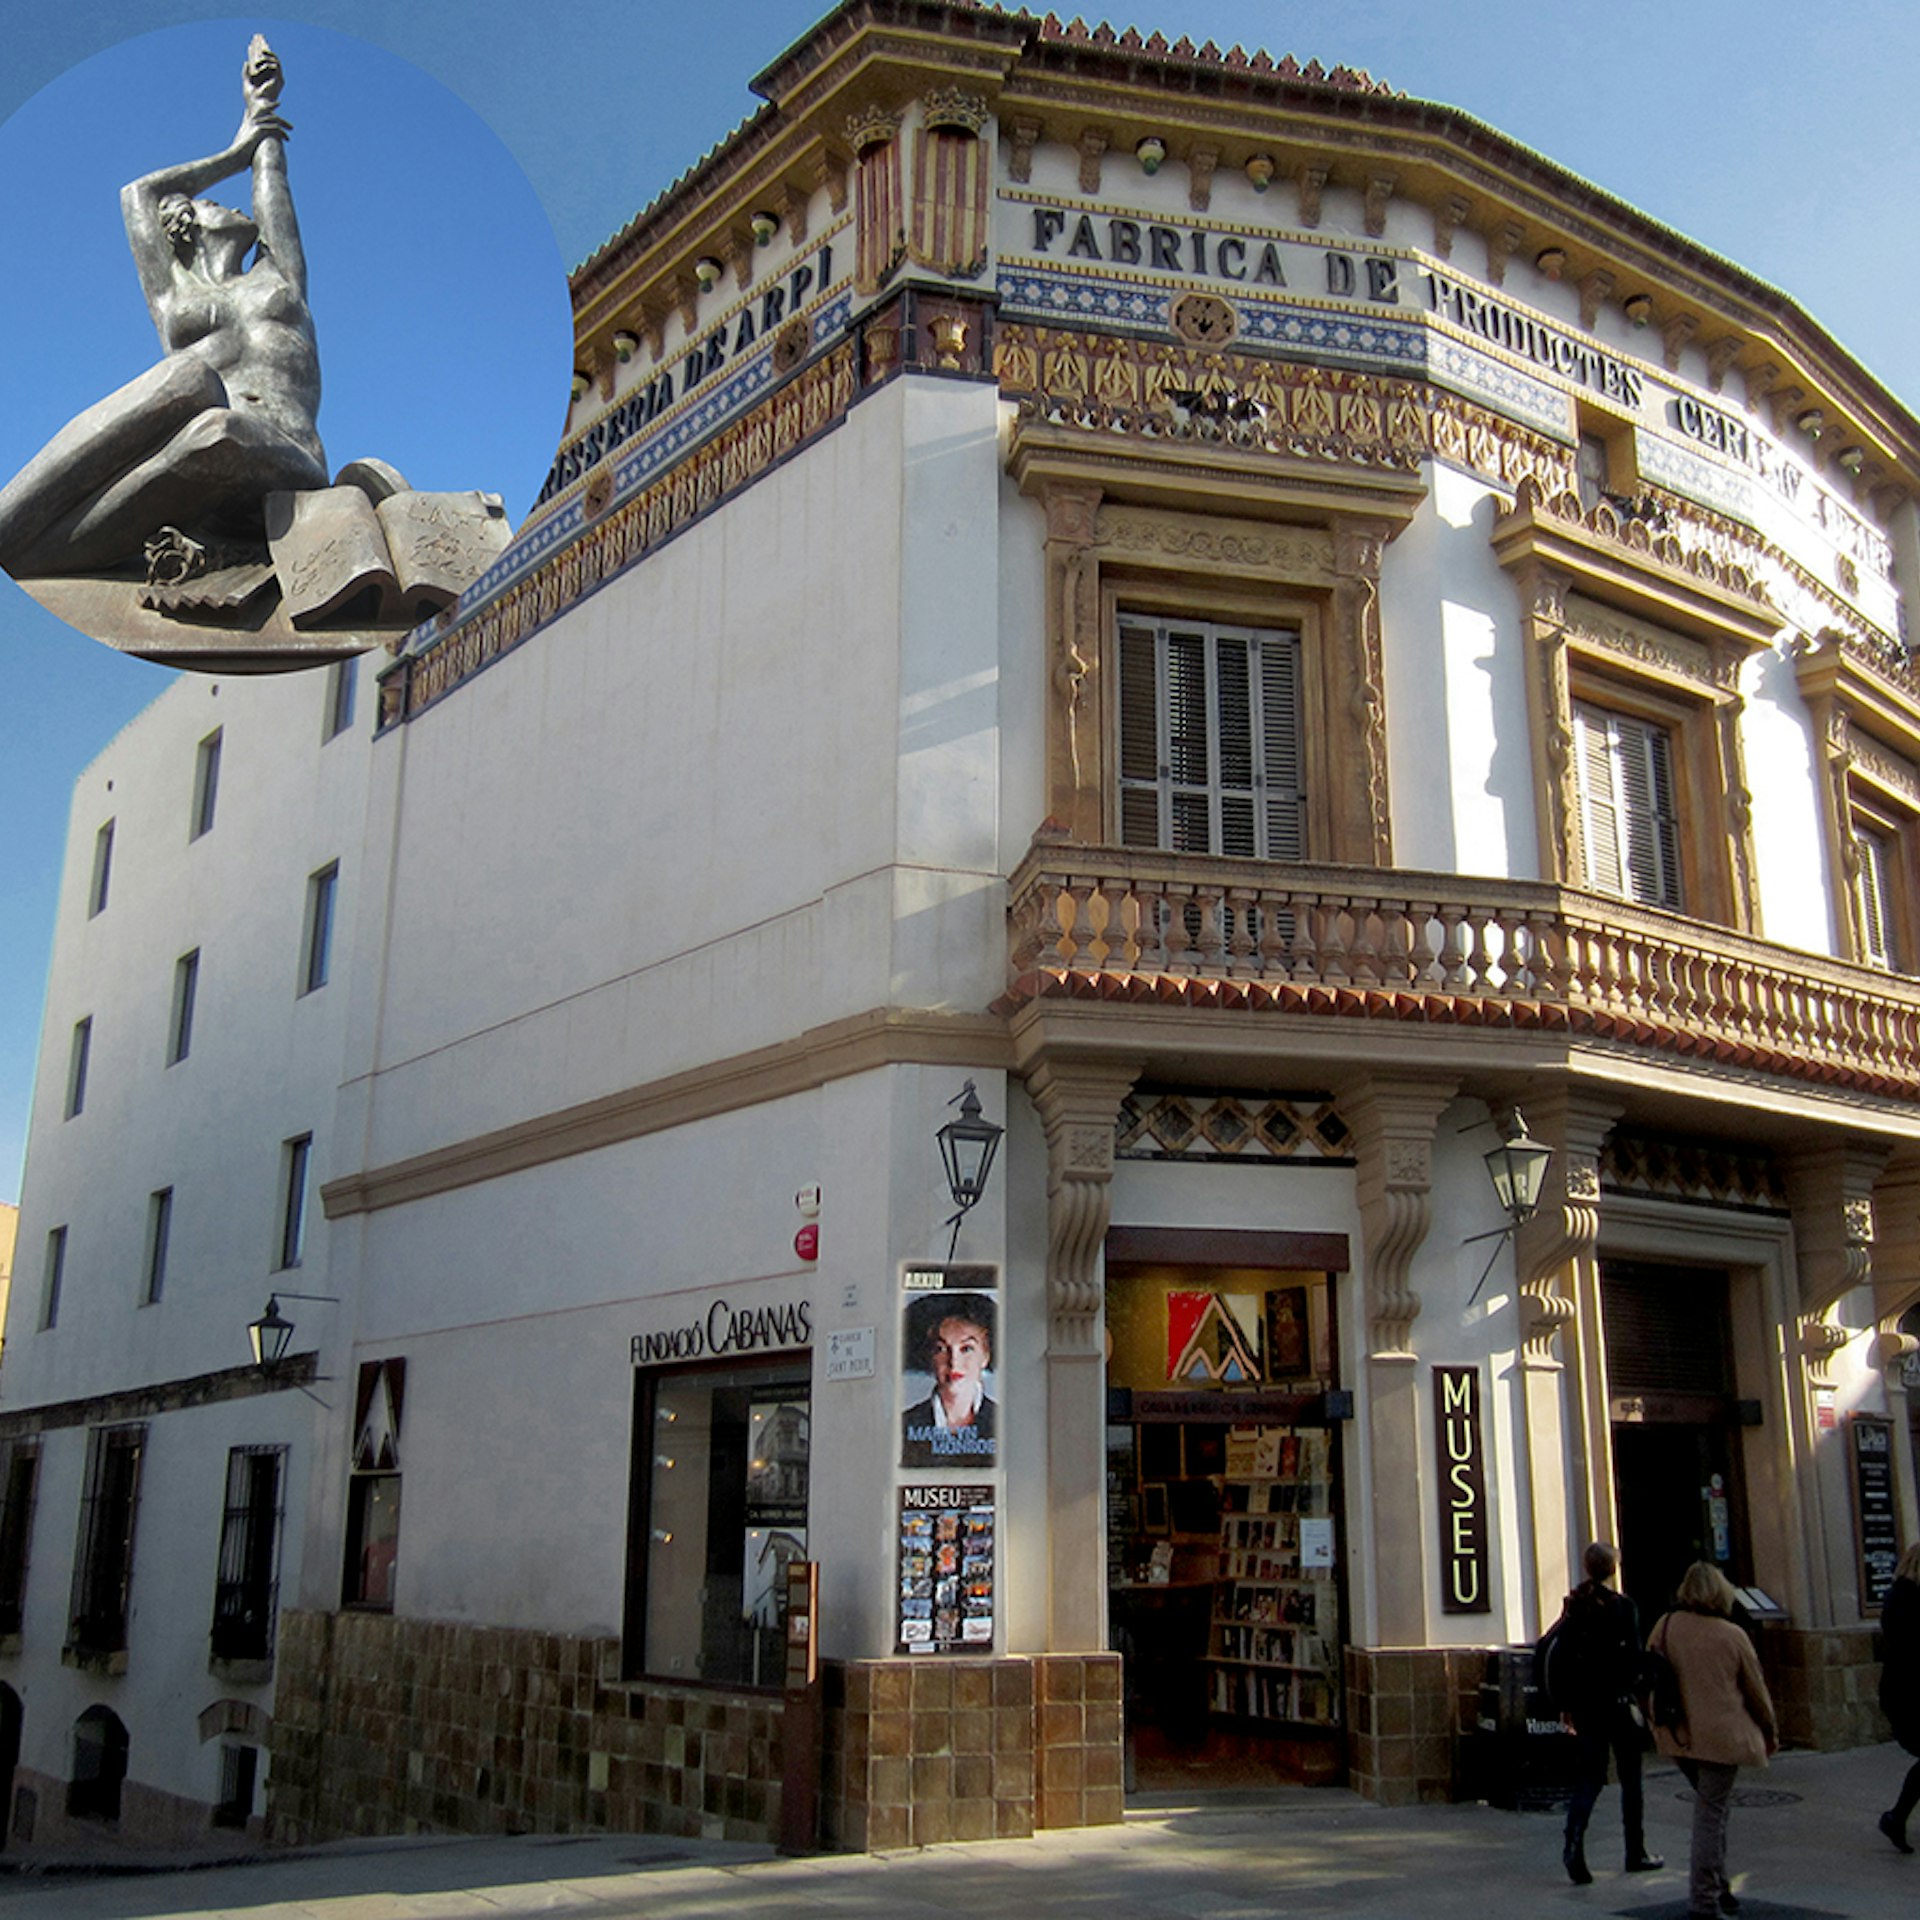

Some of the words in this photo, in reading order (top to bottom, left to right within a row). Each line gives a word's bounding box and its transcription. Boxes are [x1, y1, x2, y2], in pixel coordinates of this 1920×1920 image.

[682, 324, 728, 394] DE
[733, 245, 833, 356] ARPI
[1032, 208, 1287, 288] FABRICA
[1325, 250, 1399, 305] DE
[1429, 272, 1645, 412] PRODUCTES
[630, 1320, 705, 1364] FUNDACIÓ
[706, 1299, 813, 1354] CABANAS
[903, 1486, 961, 1508] MUSEU
[1441, 1371, 1480, 1605] MUSEU
